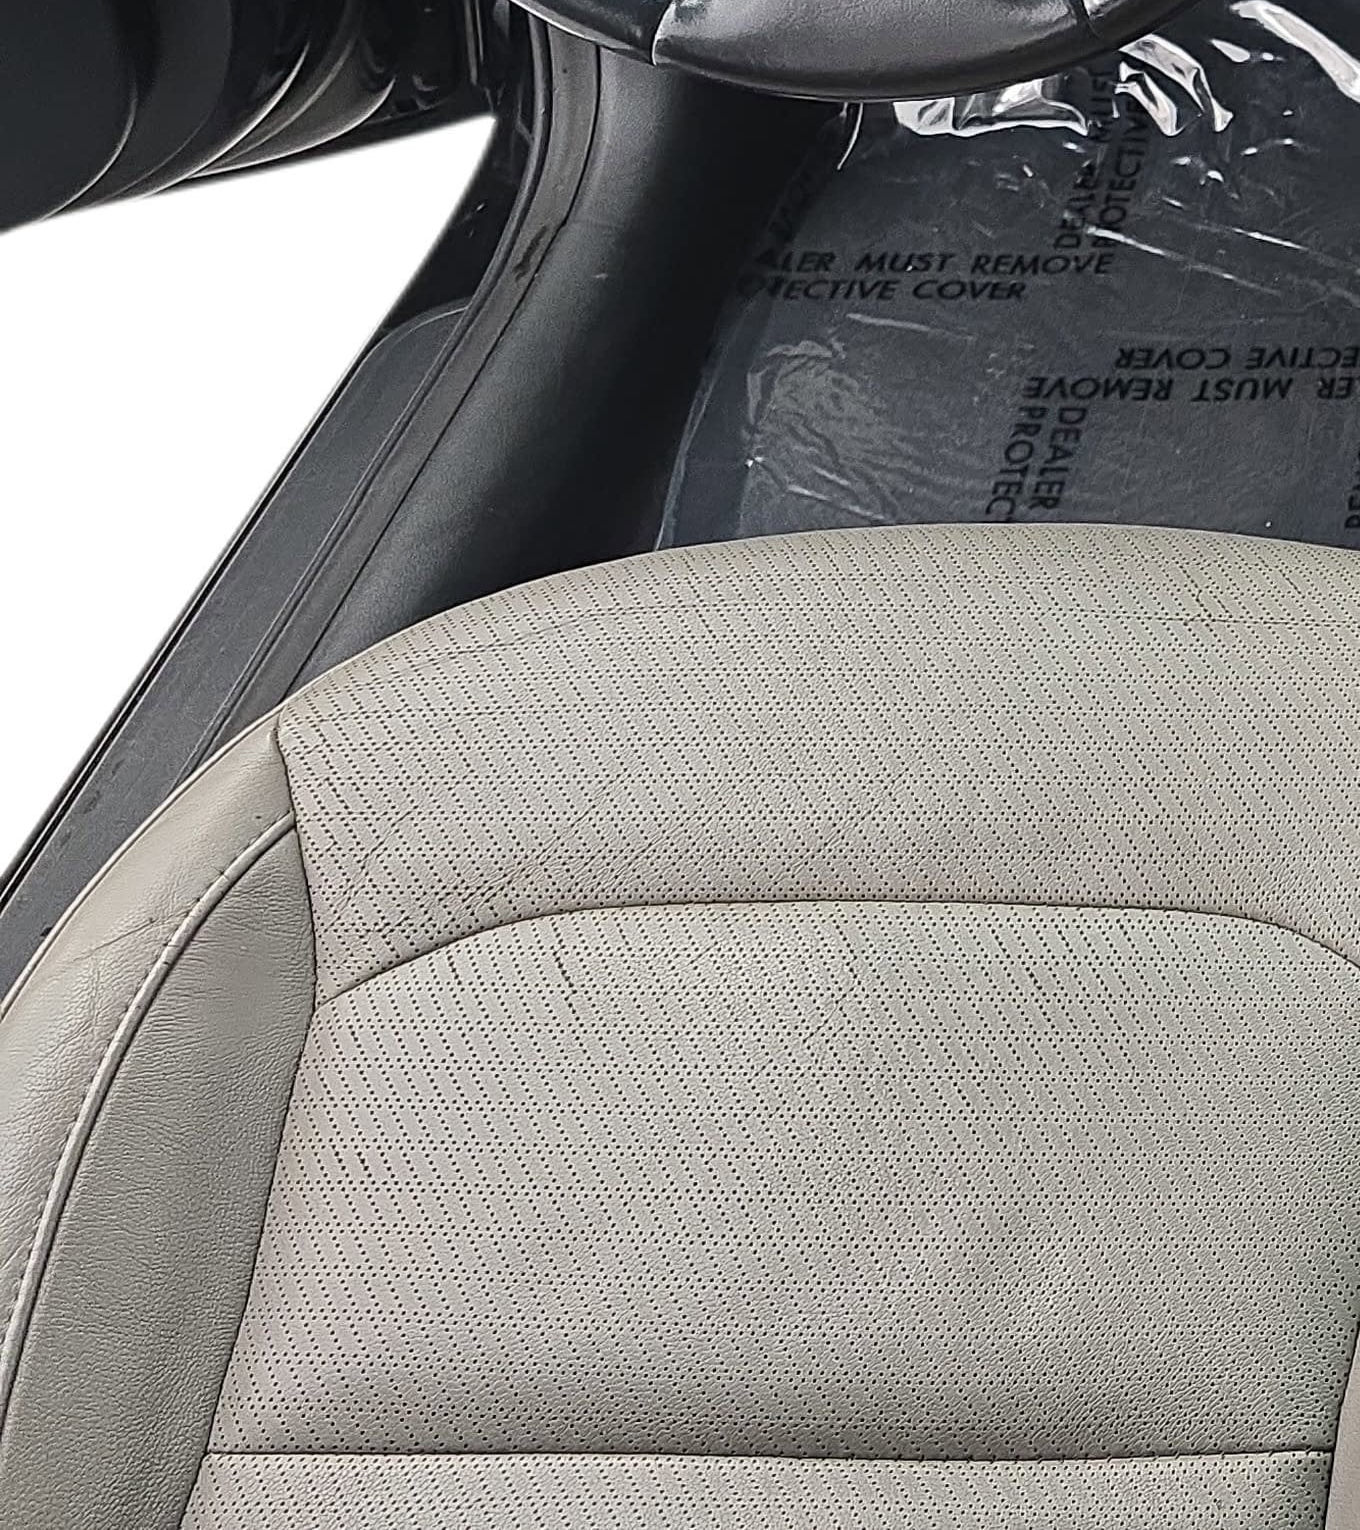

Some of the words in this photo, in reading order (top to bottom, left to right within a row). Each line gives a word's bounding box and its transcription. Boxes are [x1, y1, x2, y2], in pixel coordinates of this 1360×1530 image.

[855, 252, 957, 272] MUST
[971, 253, 1114, 275] REMOVE
[912, 280, 1027, 301] COVER
[1115, 346, 1232, 370] COVER
[1022, 375, 1175, 402] REMOVE
[1191, 377, 1293, 402] MUST
[985, 406, 1050, 520] PROTEC
[1027, 406, 1089, 510] DEALER
